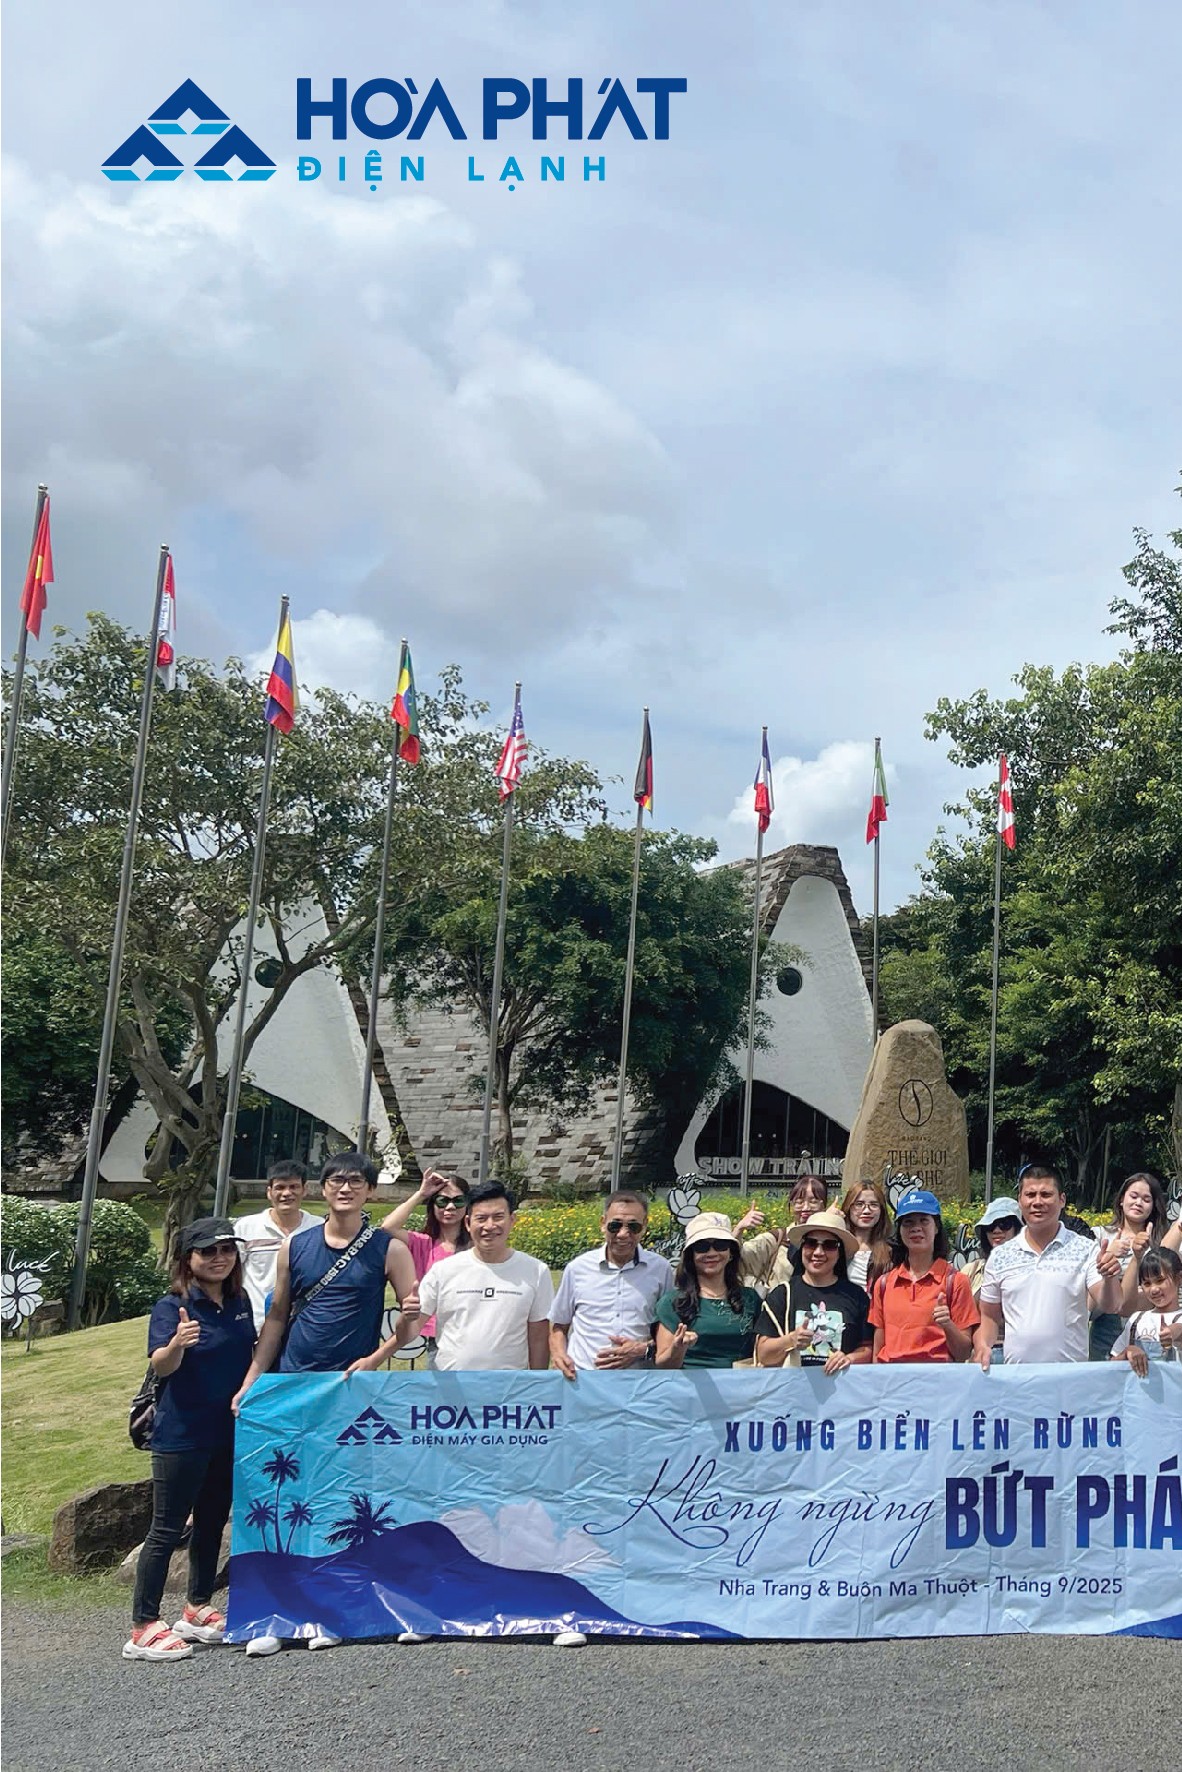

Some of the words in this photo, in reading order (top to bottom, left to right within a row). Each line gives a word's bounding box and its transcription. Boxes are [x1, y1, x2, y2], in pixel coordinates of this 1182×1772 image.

[411, 1405, 477, 1430] HÒA
[483, 1405, 561, 1430] PHÁT
[412, 1434, 444, 1448] ĐIỆN
[448, 1433, 477, 1446] MÁY
[481, 1435, 505, 1446] GIA
[509, 1435, 548, 1449] DỤNG
[724, 1413, 836, 1453] XUỐNG
[858, 1410, 930, 1452] BIỂN
[952, 1410, 1009, 1452] LÊN
[1033, 1411, 1122, 1449] RỪNG
[583, 1455, 783, 1568] Không
[797, 1490, 935, 1569] ngừng
[946, 1460, 1054, 1550] BỨT
[719, 1579, 755, 1597] Nha
[763, 1579, 812, 1600] Trang
[818, 1580, 830, 1597] &
[838, 1578, 882, 1598] Buôn
[890, 1580, 917, 1597] Ma
[924, 1578, 978, 1599] Thuột
[996, 1575, 1052, 1598] Tháng
[1058, 1576, 1123, 1596] 9/2025
